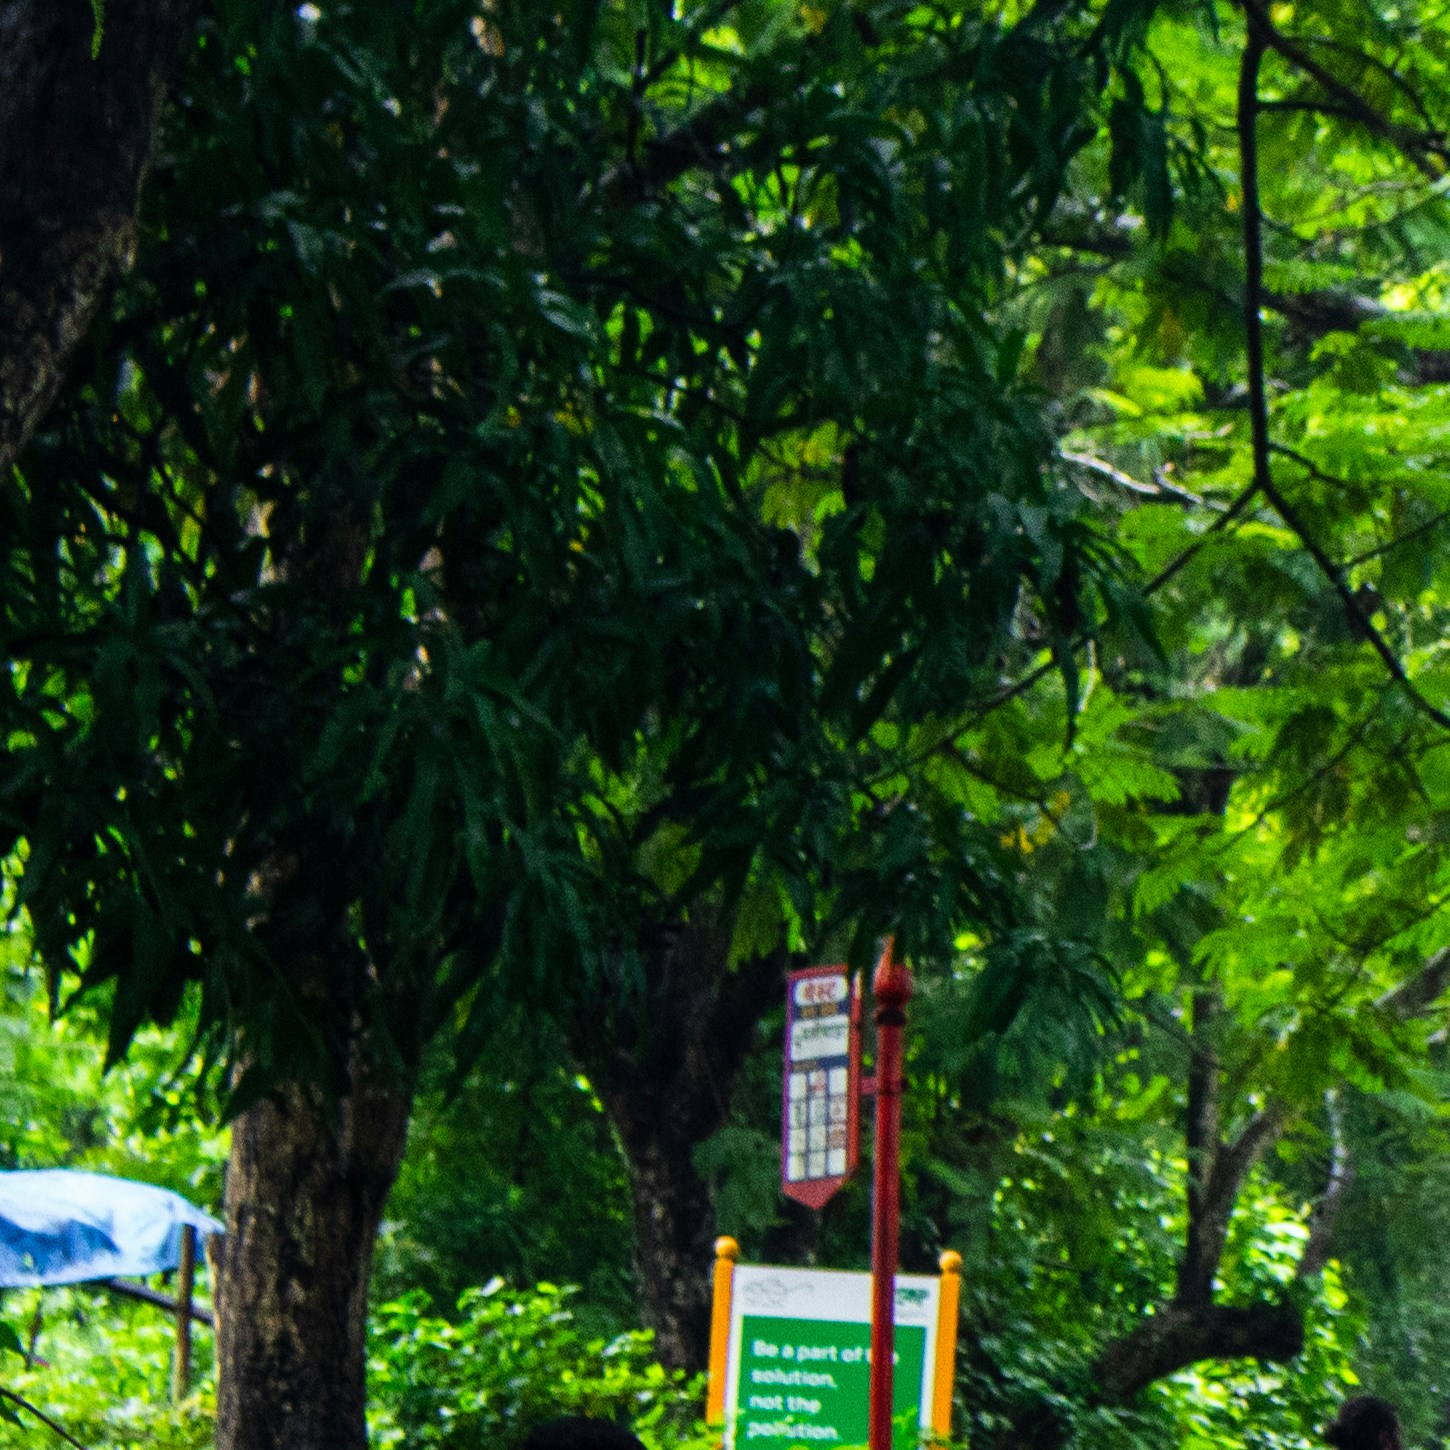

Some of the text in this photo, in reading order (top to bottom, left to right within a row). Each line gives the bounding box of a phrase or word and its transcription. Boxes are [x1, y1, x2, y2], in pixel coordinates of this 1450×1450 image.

[752, 1340, 779, 1358] Be
[782, 1344, 794, 1358] a
[796, 1345, 838, 1363] part
[841, 1347, 863, 1363] of
[749, 1395, 821, 1414] not the
